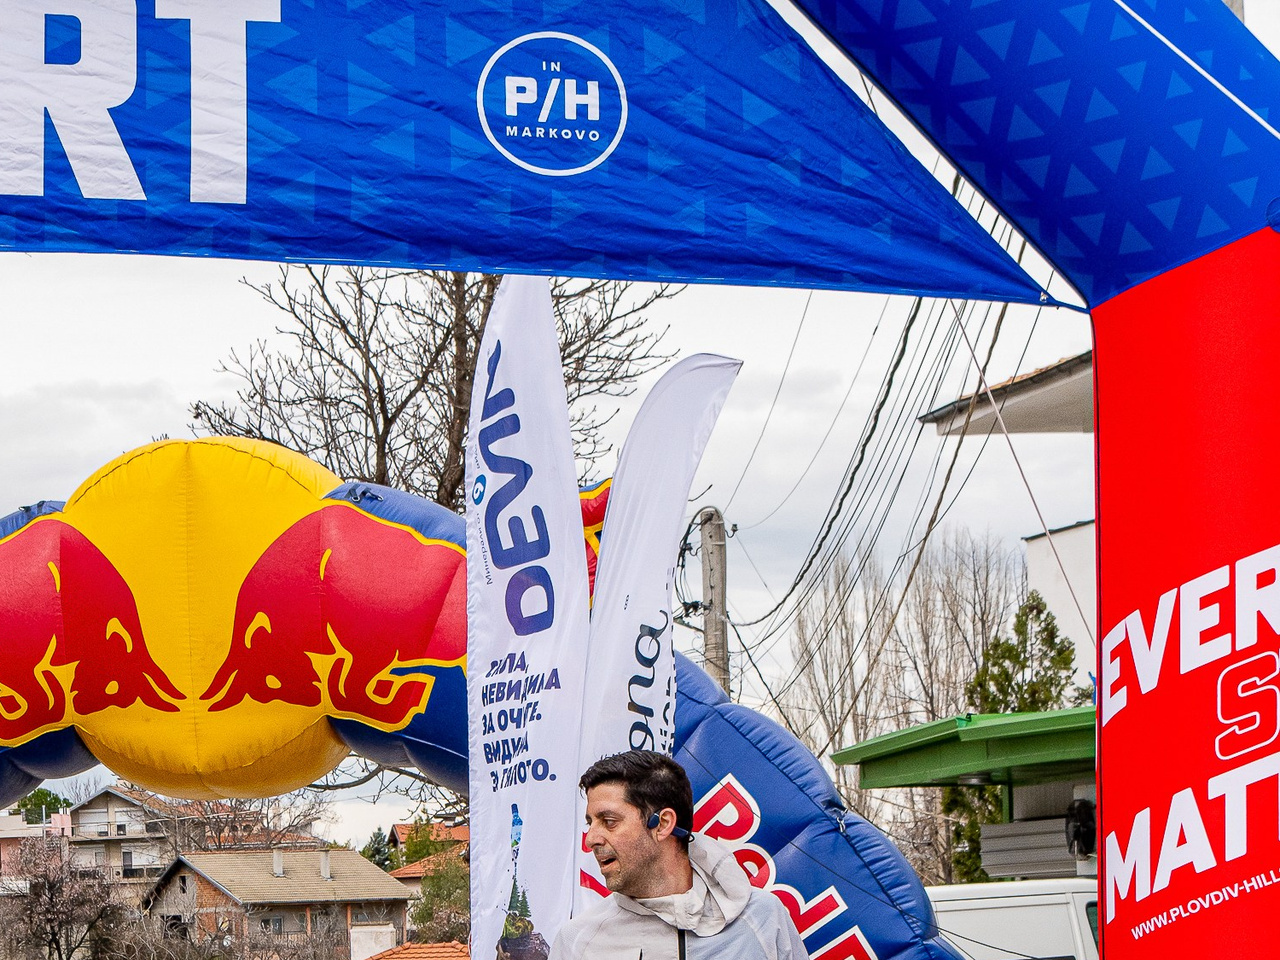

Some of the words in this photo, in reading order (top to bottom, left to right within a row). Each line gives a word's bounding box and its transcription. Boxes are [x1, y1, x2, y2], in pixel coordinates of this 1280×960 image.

[542, 60, 561, 71] IN
[505, 125, 601, 142] MARKOVO
[1102, 544, 1280, 728] EVER
[482, 712, 495, 736] ЗА
[1131, 866, 1280, 940] WWW.PLOVDIV-HILL
